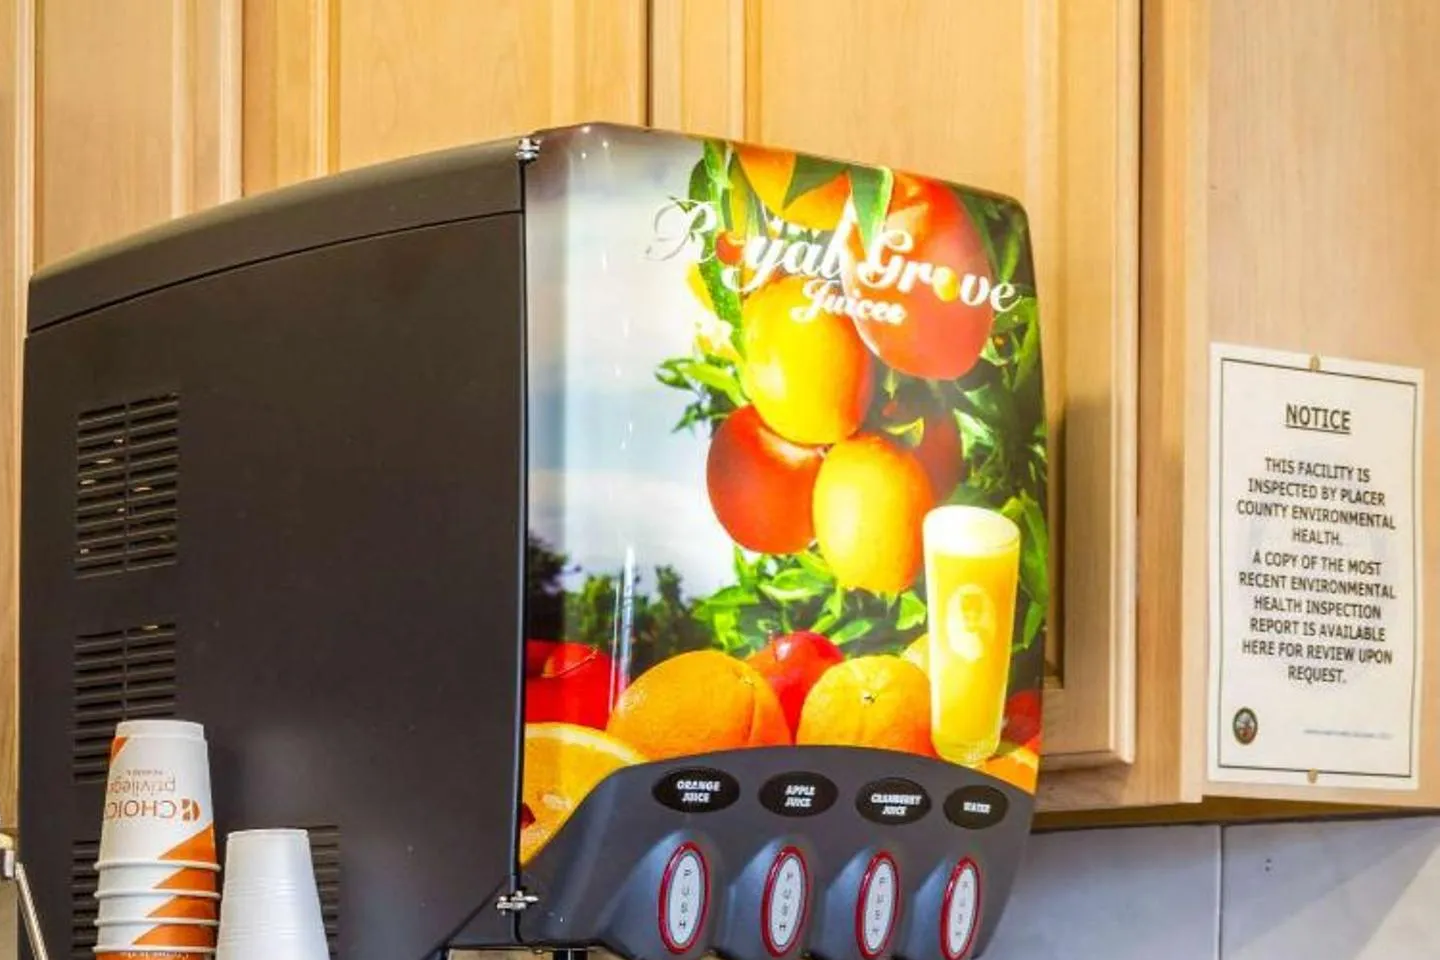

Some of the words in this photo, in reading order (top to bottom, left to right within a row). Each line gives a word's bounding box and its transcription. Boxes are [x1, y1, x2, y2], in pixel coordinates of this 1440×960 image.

[1286, 403, 1351, 431] NOTICE
[1265, 457, 1295, 475] THIS
[1298, 462, 1354, 481] FACILITY
[1357, 467, 1371, 483] IS
[1248, 478, 1317, 498] INSPECTED
[1321, 486, 1337, 500] BY
[1340, 488, 1385, 506] PLACER
[1237, 499, 1288, 518] COUNTY
[1292, 505, 1396, 530] ENVIRONMENTAL
[1292, 528, 1343, 546] HEALTH.
[1253, 550, 1261, 564] A
[1265, 551, 1297, 567] COPY
[1301, 555, 1319, 570] OF
[1321, 556, 1344, 572] THE
[1348, 559, 1382, 575] MOST
[1239, 572, 1287, 592] RECENT
[1291, 576, 1397, 600] ENVIRONMENTAL
[1254, 596, 1302, 613] HEALTH
[1306, 600, 1381, 620] INSPECTION
[1250, 617, 1300, 634] REPORT
[1303, 622, 1316, 636] IS
[1319, 624, 1385, 642] AVAILABLE
[1242, 640, 1275, 656] HERE
[1278, 642, 1303, 658] FOR
[1306, 645, 1356, 661] REVIEW
[1358, 650, 1393, 665] UPON
[1288, 665, 1347, 685] REQUEST.
[676, 779, 721, 792] ORANGE
[681, 791, 711, 804] JUICE
[784, 784, 816, 797] APPLE
[105, 800, 177, 820] CHOIC
[784, 796, 813, 808] JUICE
